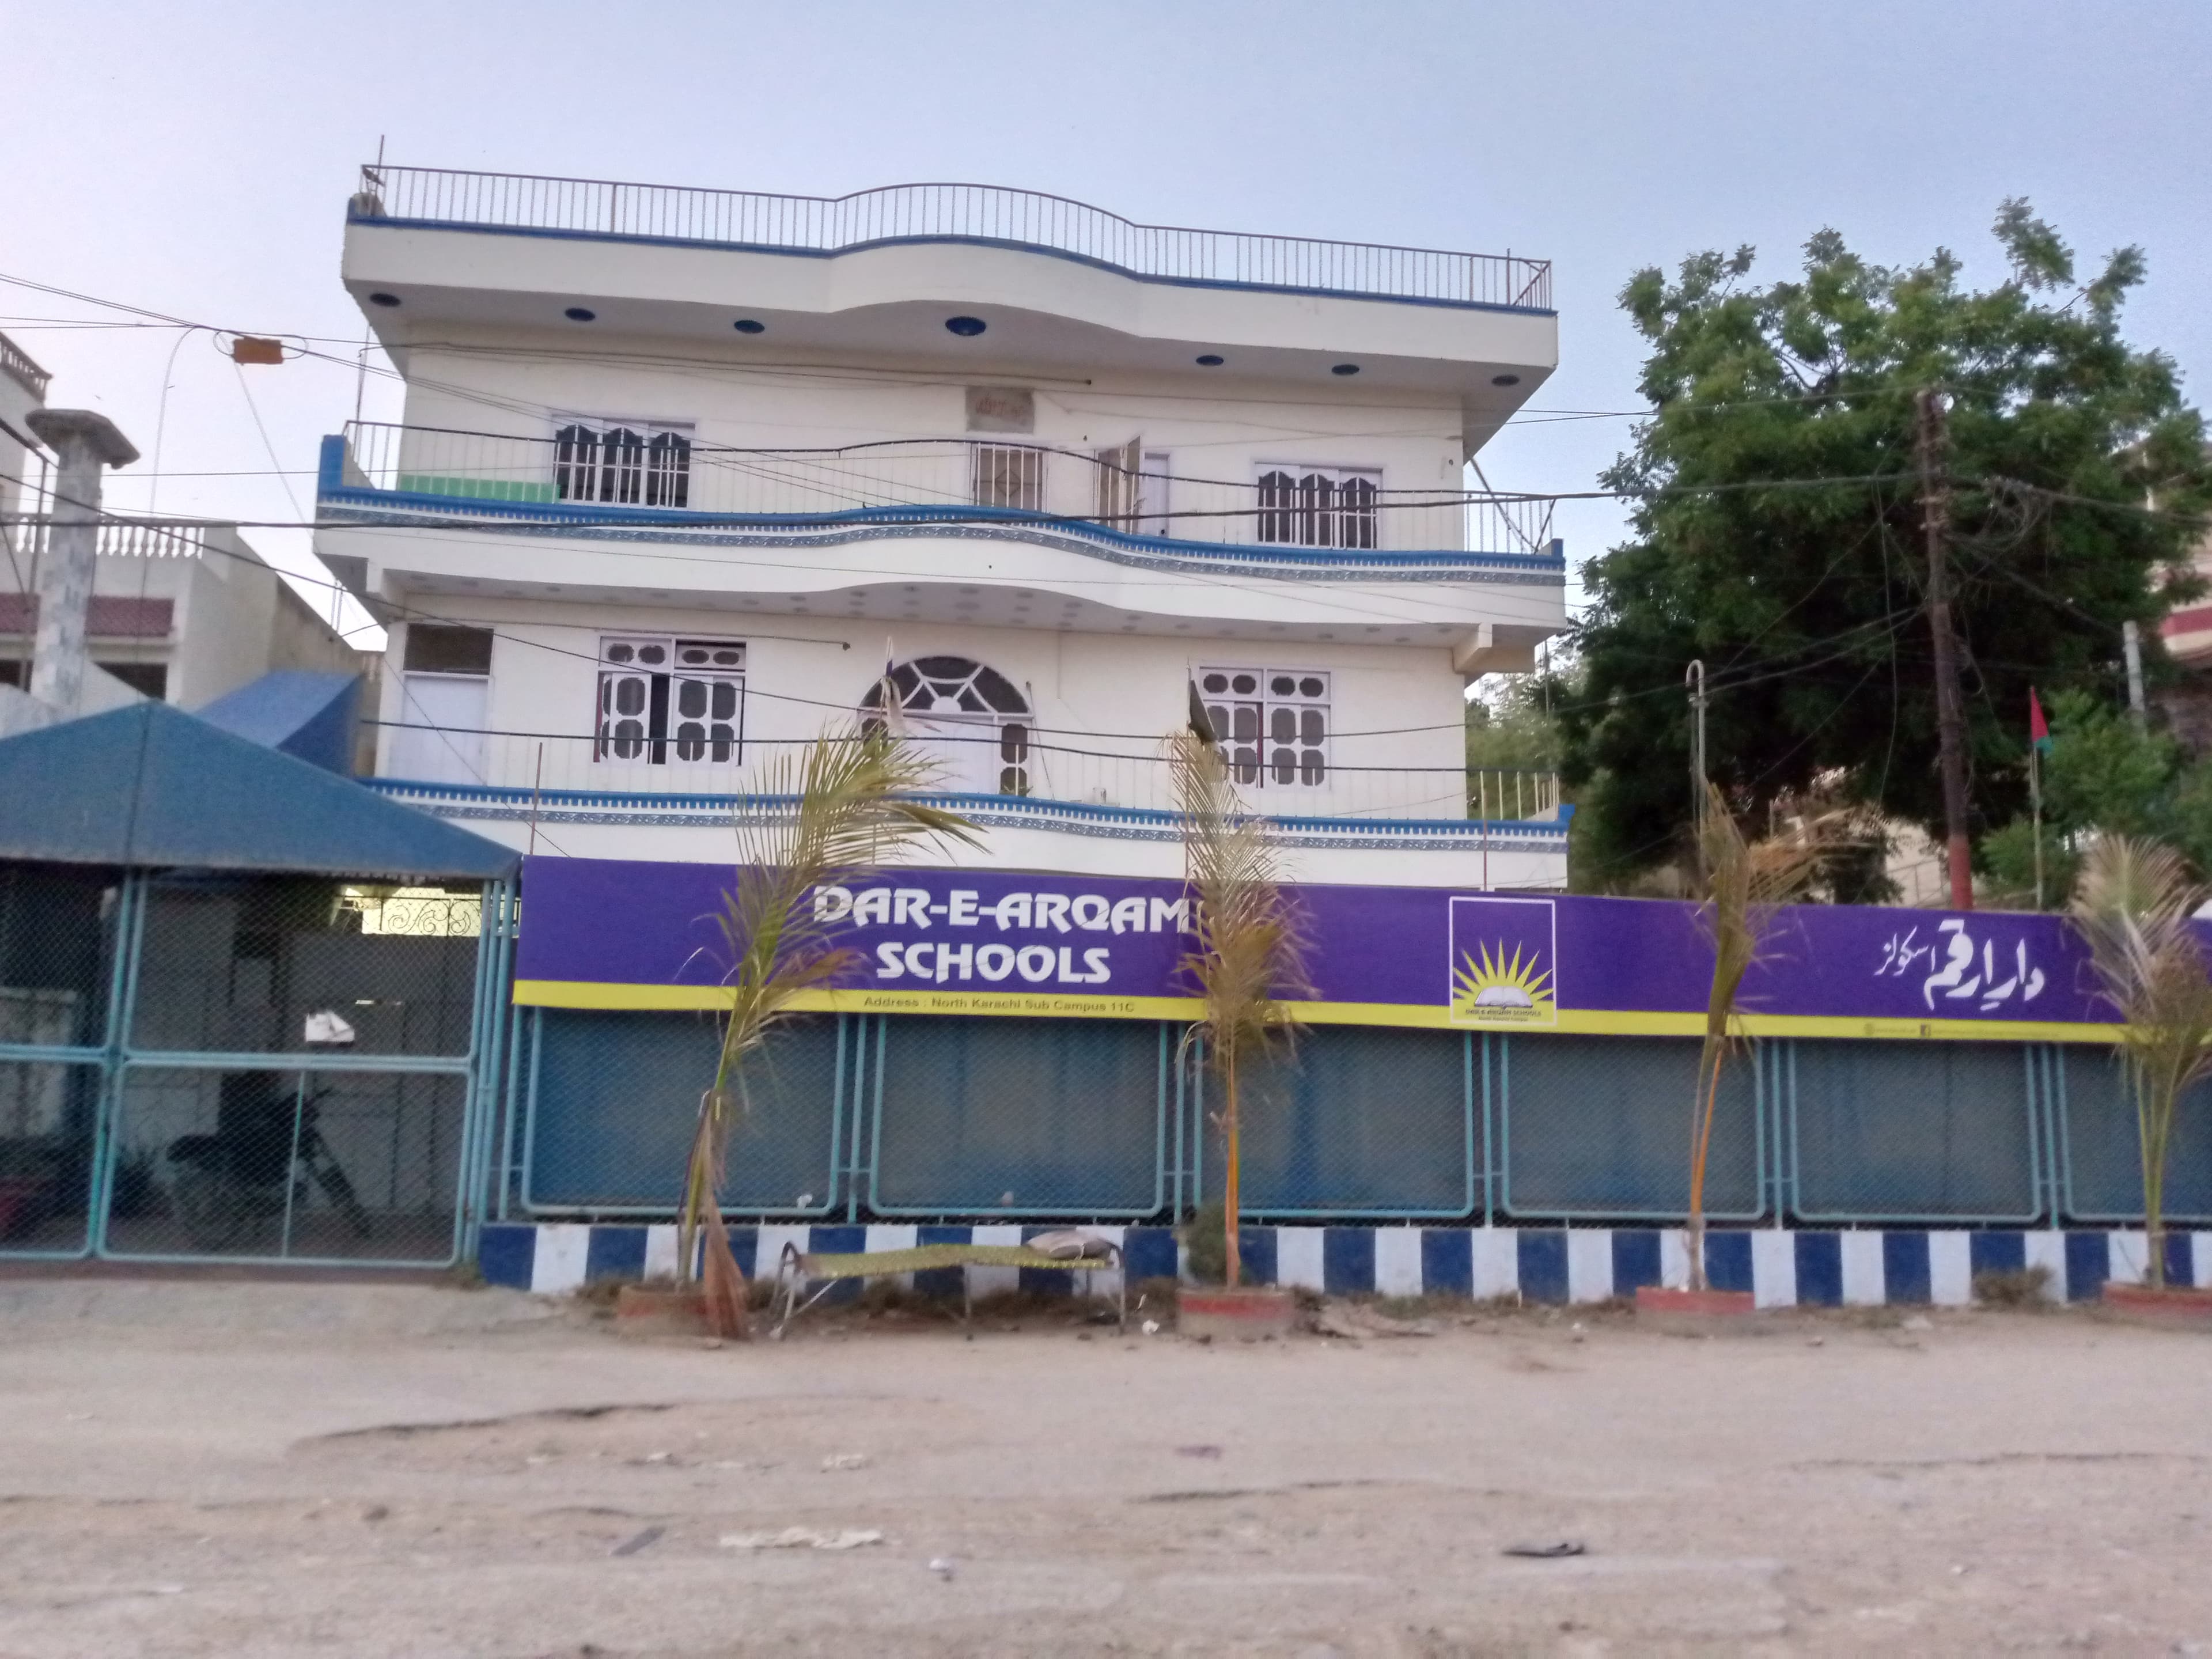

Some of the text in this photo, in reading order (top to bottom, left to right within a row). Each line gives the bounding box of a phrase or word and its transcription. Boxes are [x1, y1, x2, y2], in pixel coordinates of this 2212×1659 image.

[813, 885, 1190, 935] DAR-E-ARQAM
[876, 941, 1111, 983] SCHOOLS
[864, 996, 919, 1007] Address
[931, 997, 967, 1008] North
[972, 998, 1021, 1009] Karachi
[1025, 998, 1050, 1010] Sub
[1054, 1000, 1107, 1012] Campus
[1111, 1001, 1135, 1013] 11C
